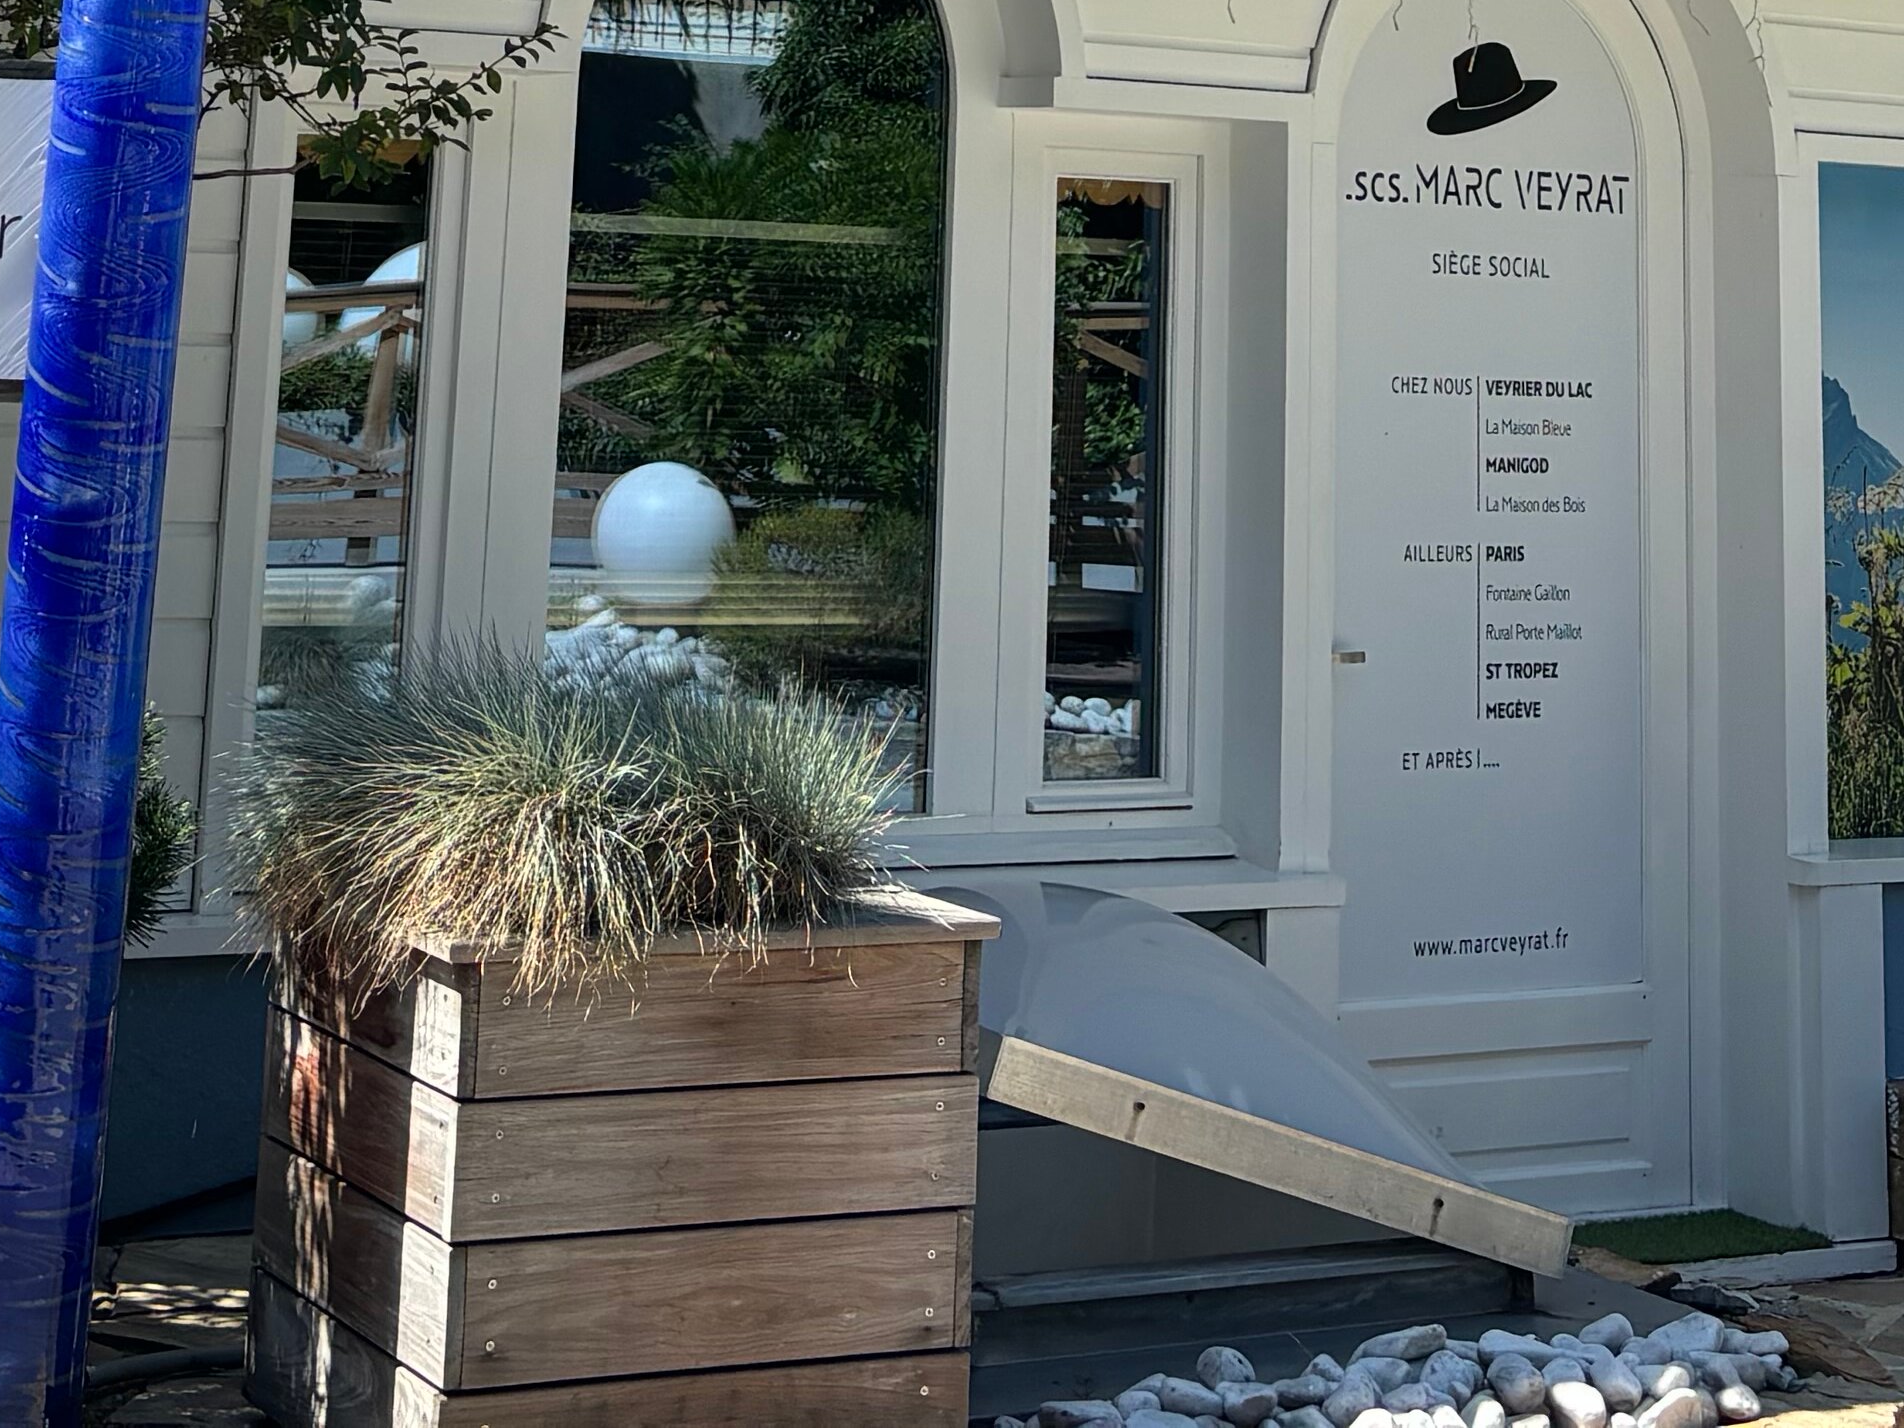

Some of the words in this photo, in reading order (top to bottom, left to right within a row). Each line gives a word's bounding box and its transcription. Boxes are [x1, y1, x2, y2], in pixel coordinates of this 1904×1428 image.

[1416, 164, 1503, 210] MARC
[1515, 168, 1630, 214] VEYRAT
[1432, 250, 1482, 277] SIÈGE
[1489, 255, 1550, 278] SOCIAL
[1391, 376, 1428, 395] CHEZ
[1434, 377, 1473, 396] NOUS
[1485, 379, 1543, 398] VEYRIER
[1546, 382, 1564, 398] DU
[1568, 382, 1593, 399] LAC
[1485, 419, 1499, 435] La
[1502, 419, 1540, 436] Maison
[1543, 420, 1572, 437] Bleue
[1485, 457, 1549, 474] MANIGOD
[1485, 496, 1499, 513] La
[1502, 496, 1540, 513] Maison
[1543, 496, 1560, 513] des
[1564, 496, 1586, 513] Bois
[1404, 544, 1472, 563] AILLEURS
[1485, 545, 1525, 562] PARIS
[1486, 585, 1532, 601] Fontaine
[1516, 624, 1544, 641] Porte
[1547, 623, 1582, 641] Maillot
[1485, 664, 1502, 680] ST
[1505, 662, 1558, 680] TROPEZ
[1402, 752, 1419, 770] ET
[1426, 748, 1472, 769] APRÈS
[1414, 927, 1568, 957] www.marcveyrat.fr
